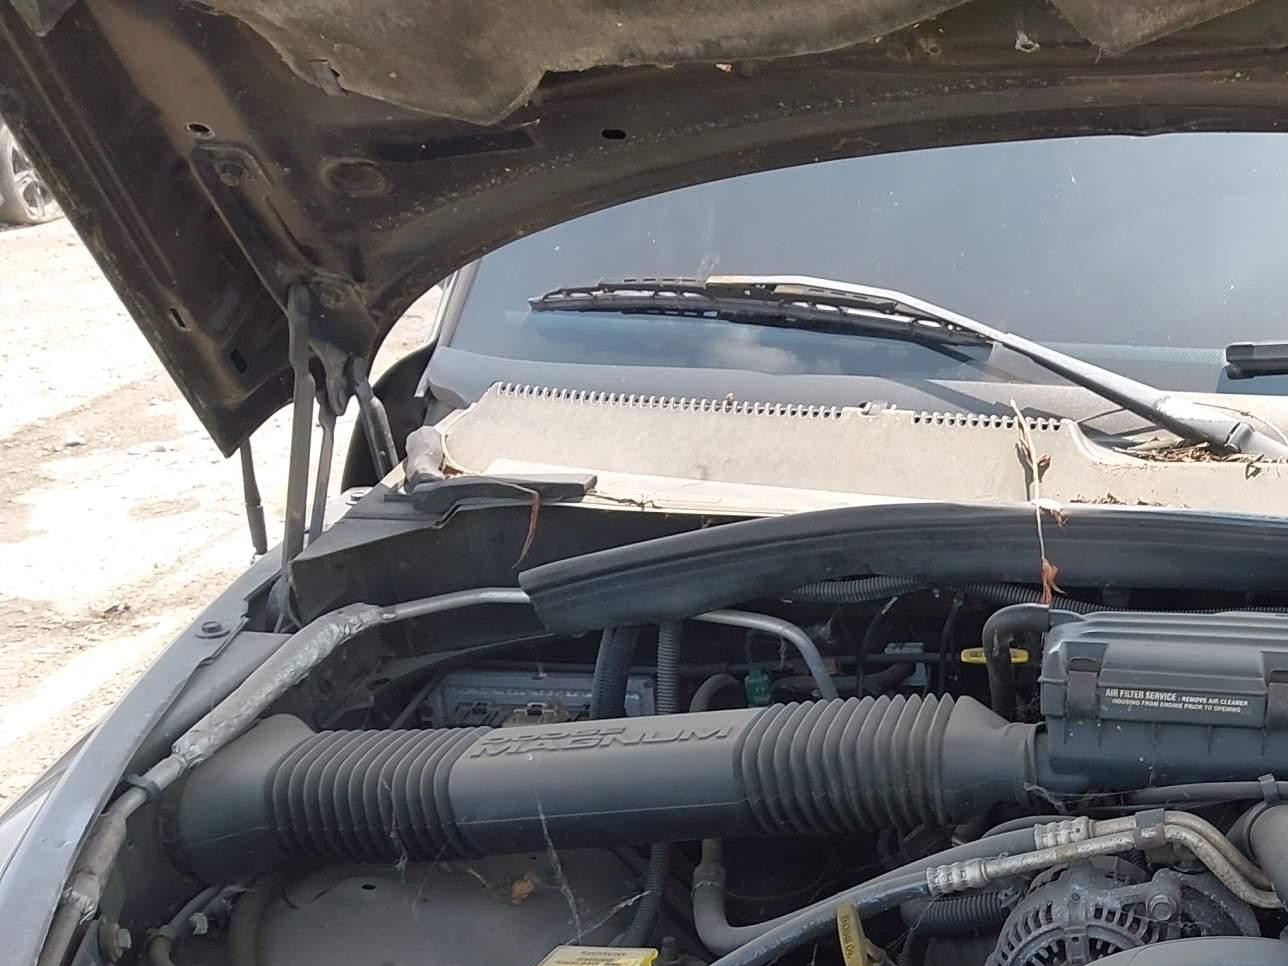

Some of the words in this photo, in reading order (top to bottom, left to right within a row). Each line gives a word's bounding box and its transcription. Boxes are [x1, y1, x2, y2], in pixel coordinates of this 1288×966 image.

[1105, 688, 1119, 698] AIR
[1120, 689, 1144, 699] FILTER
[1145, 691, 1177, 701] SERVICE
[1182, 696, 1207, 705] REMOVE
[1220, 699, 1248, 707] CLEANER
[1112, 698, 1140, 706] HOUSING
[1141, 699, 1159, 707] FROM
[1160, 701, 1183, 709] ENGINE
[1184, 702, 1203, 710] PRIOR
[1213, 705, 1241, 713] OPENING
[470, 727, 731, 759] MAGNUM
